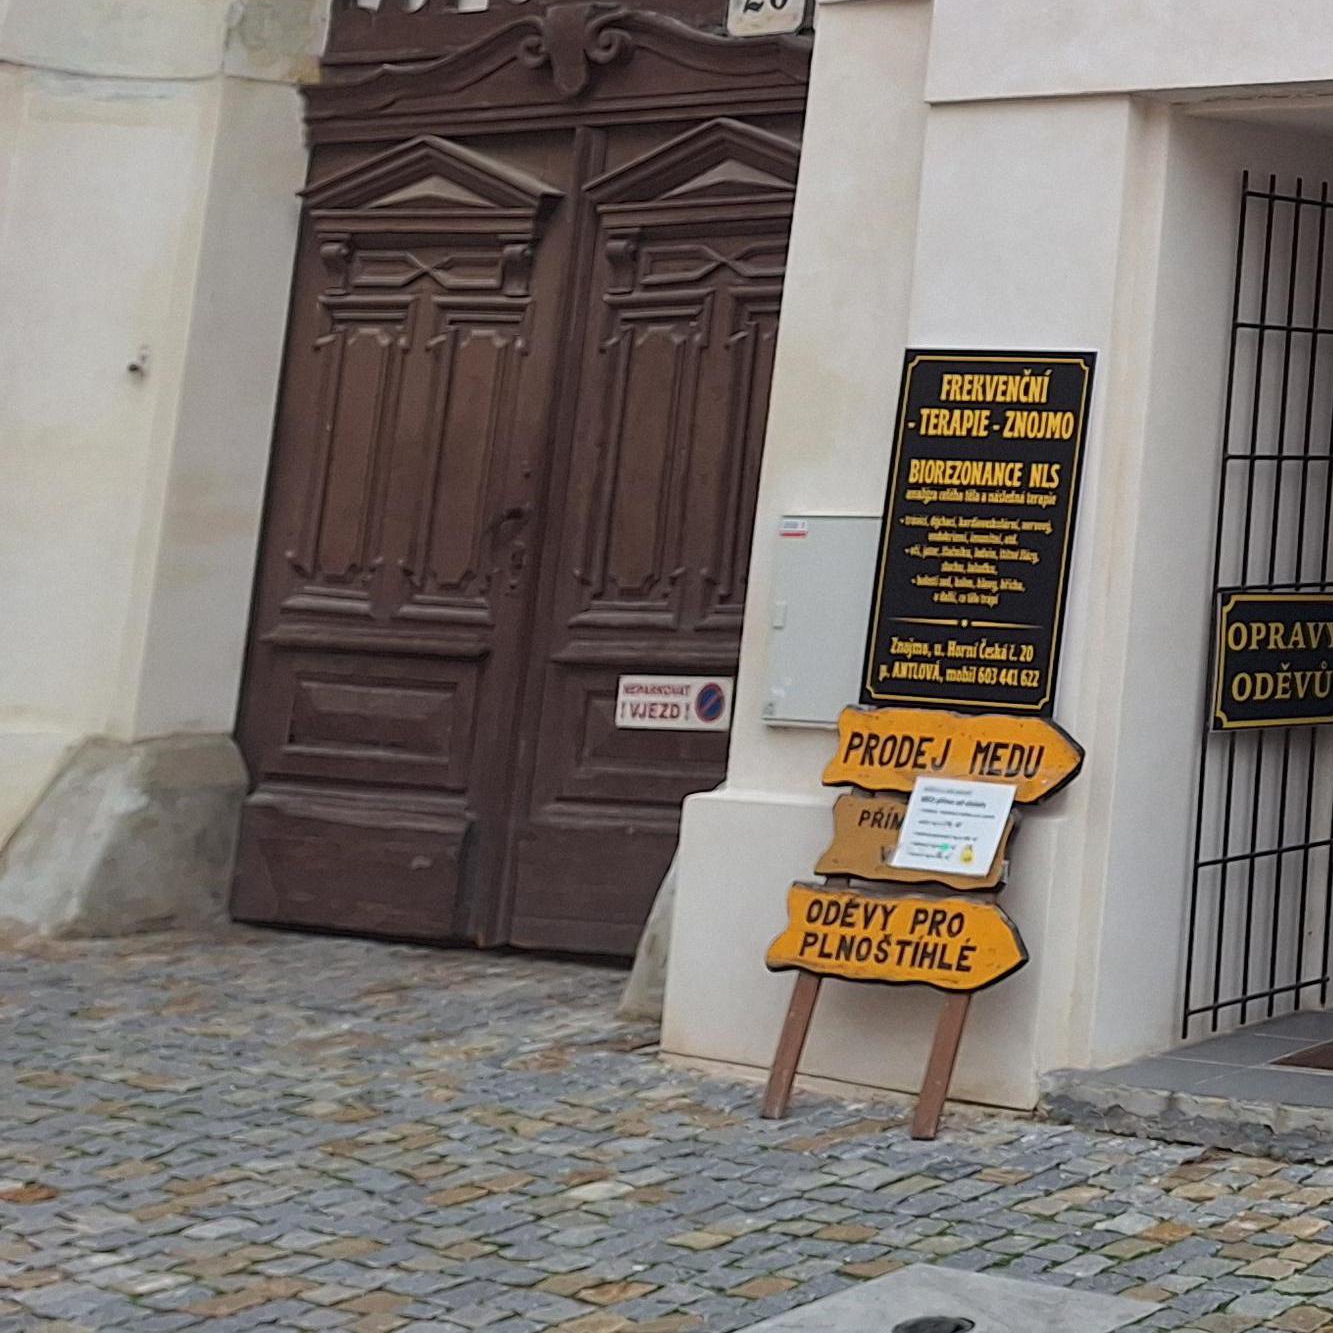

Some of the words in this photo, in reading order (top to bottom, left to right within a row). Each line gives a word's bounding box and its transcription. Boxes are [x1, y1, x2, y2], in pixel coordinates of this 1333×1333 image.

[940, 369, 1052, 403] FREKVENČNÍ
[920, 408, 990, 437] TERAPIE
[1003, 410, 1074, 439] ZNOJMO
[908, 459, 1024, 487] BIOREZONANCE
[1029, 463, 1060, 489] NLS
[948, 640, 978, 658] Horní
[1020, 645, 1034, 662] 20
[945, 666, 976, 683] mobil
[977, 667, 998, 684] 603
[999, 668, 1019, 685] 441
[1020, 669, 1040, 687] 622
[1231, 661, 1333, 702] ODĚVŮ
[630, 703, 680, 719] VJEZD
[843, 732, 952, 771] PRODEJ
[969, 740, 1045, 778] MEDU
[805, 898, 898, 931] ODĚVY
[909, 908, 965, 938] PRO
[799, 932, 977, 972] PLNOŠTÍHLÉ
